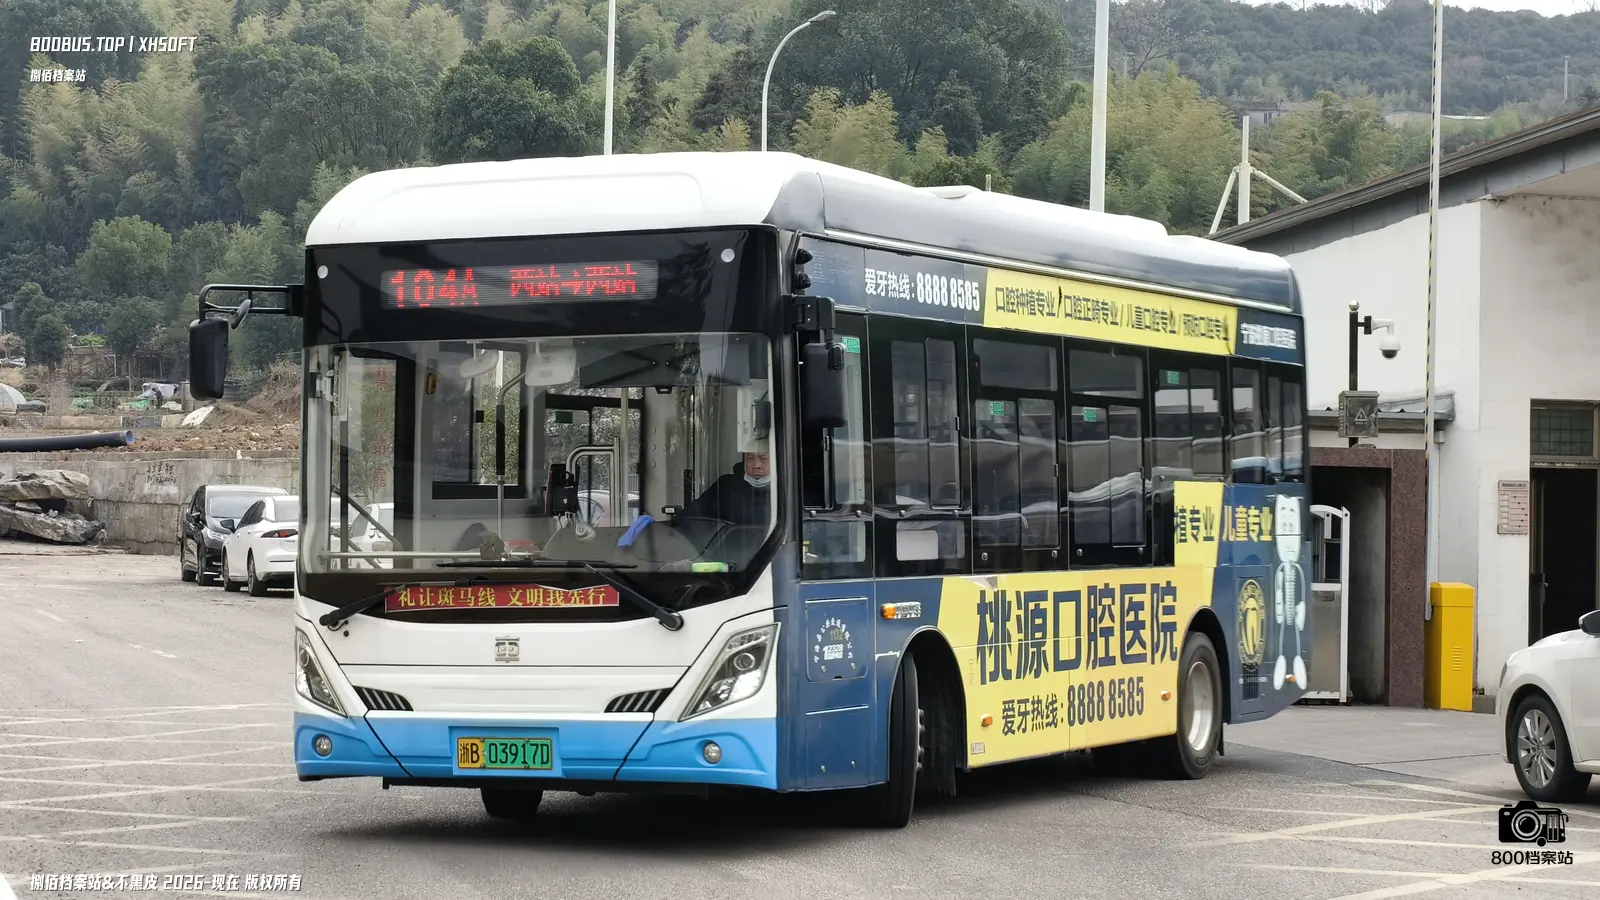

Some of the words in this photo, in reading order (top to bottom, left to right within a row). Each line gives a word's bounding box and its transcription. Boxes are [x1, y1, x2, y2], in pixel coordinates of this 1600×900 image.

[391, 269, 479, 307] 104A
[398, 587, 495, 607] 礼让斑马线
[507, 587, 606, 606] 文明我先行
[977, 581, 1177, 685] 桃源口腔医院
